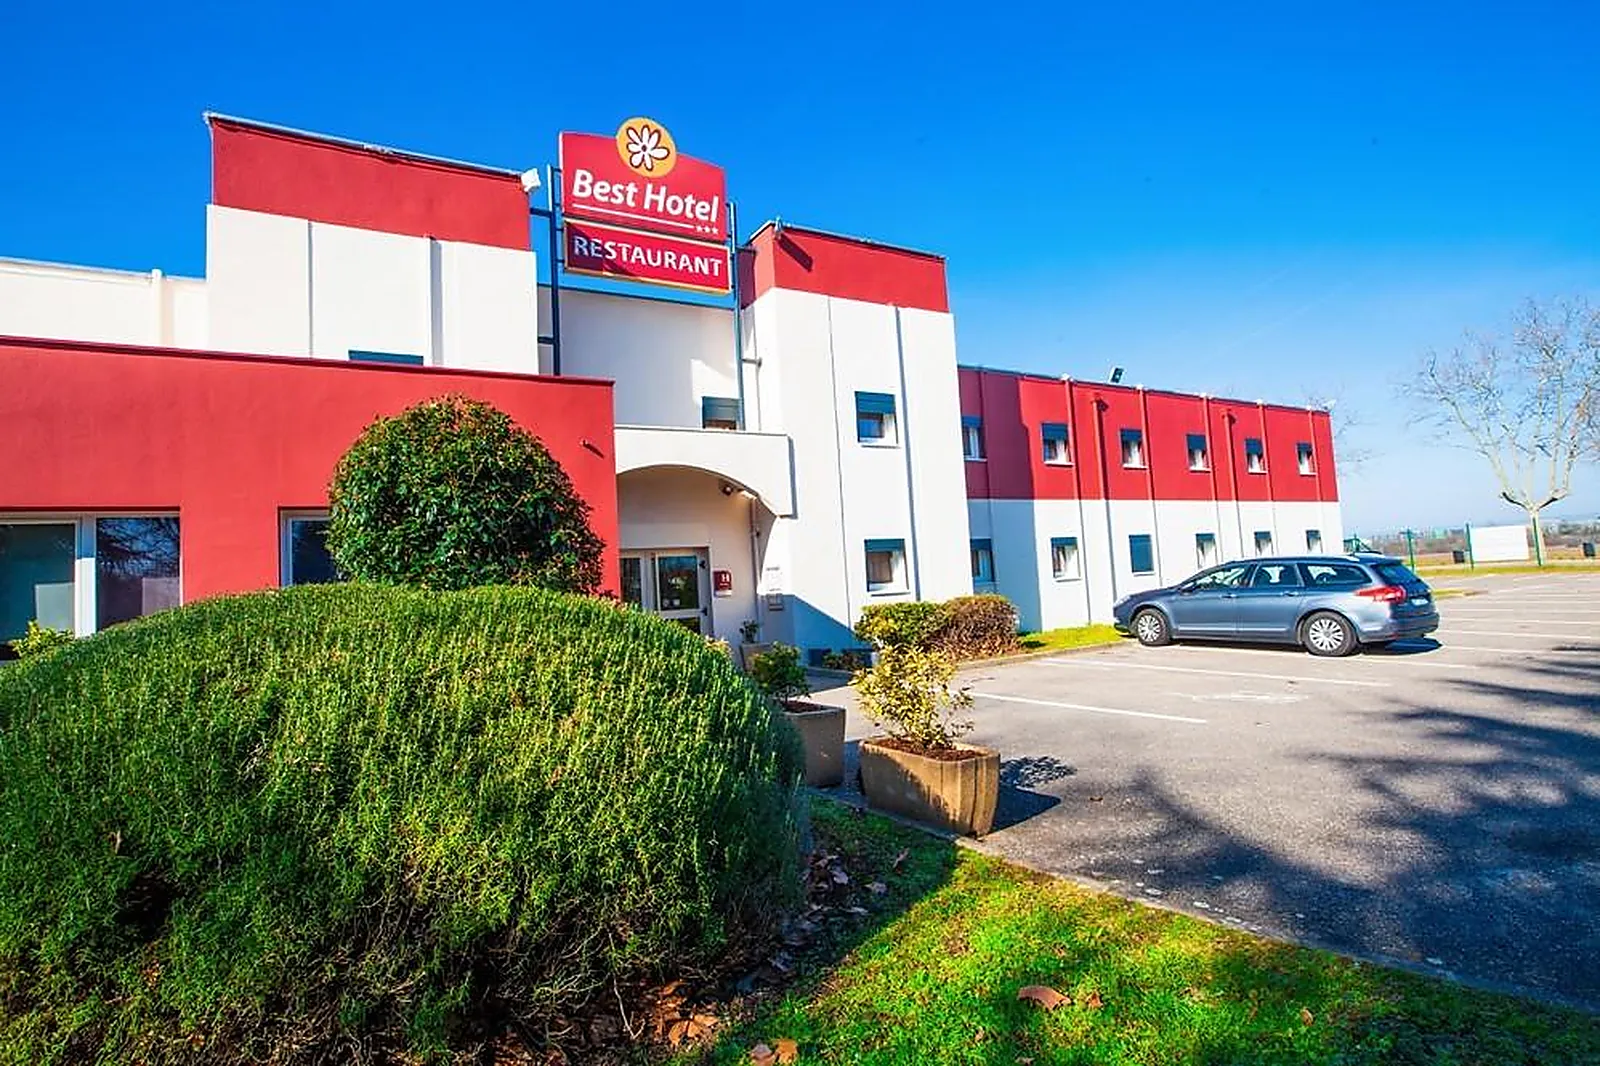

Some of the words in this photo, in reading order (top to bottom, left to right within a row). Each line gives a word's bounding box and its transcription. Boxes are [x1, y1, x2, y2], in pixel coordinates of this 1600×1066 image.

[572, 169, 639, 207] Best
[644, 183, 719, 222] Hotel
[573, 236, 722, 277] RESTAURANT
